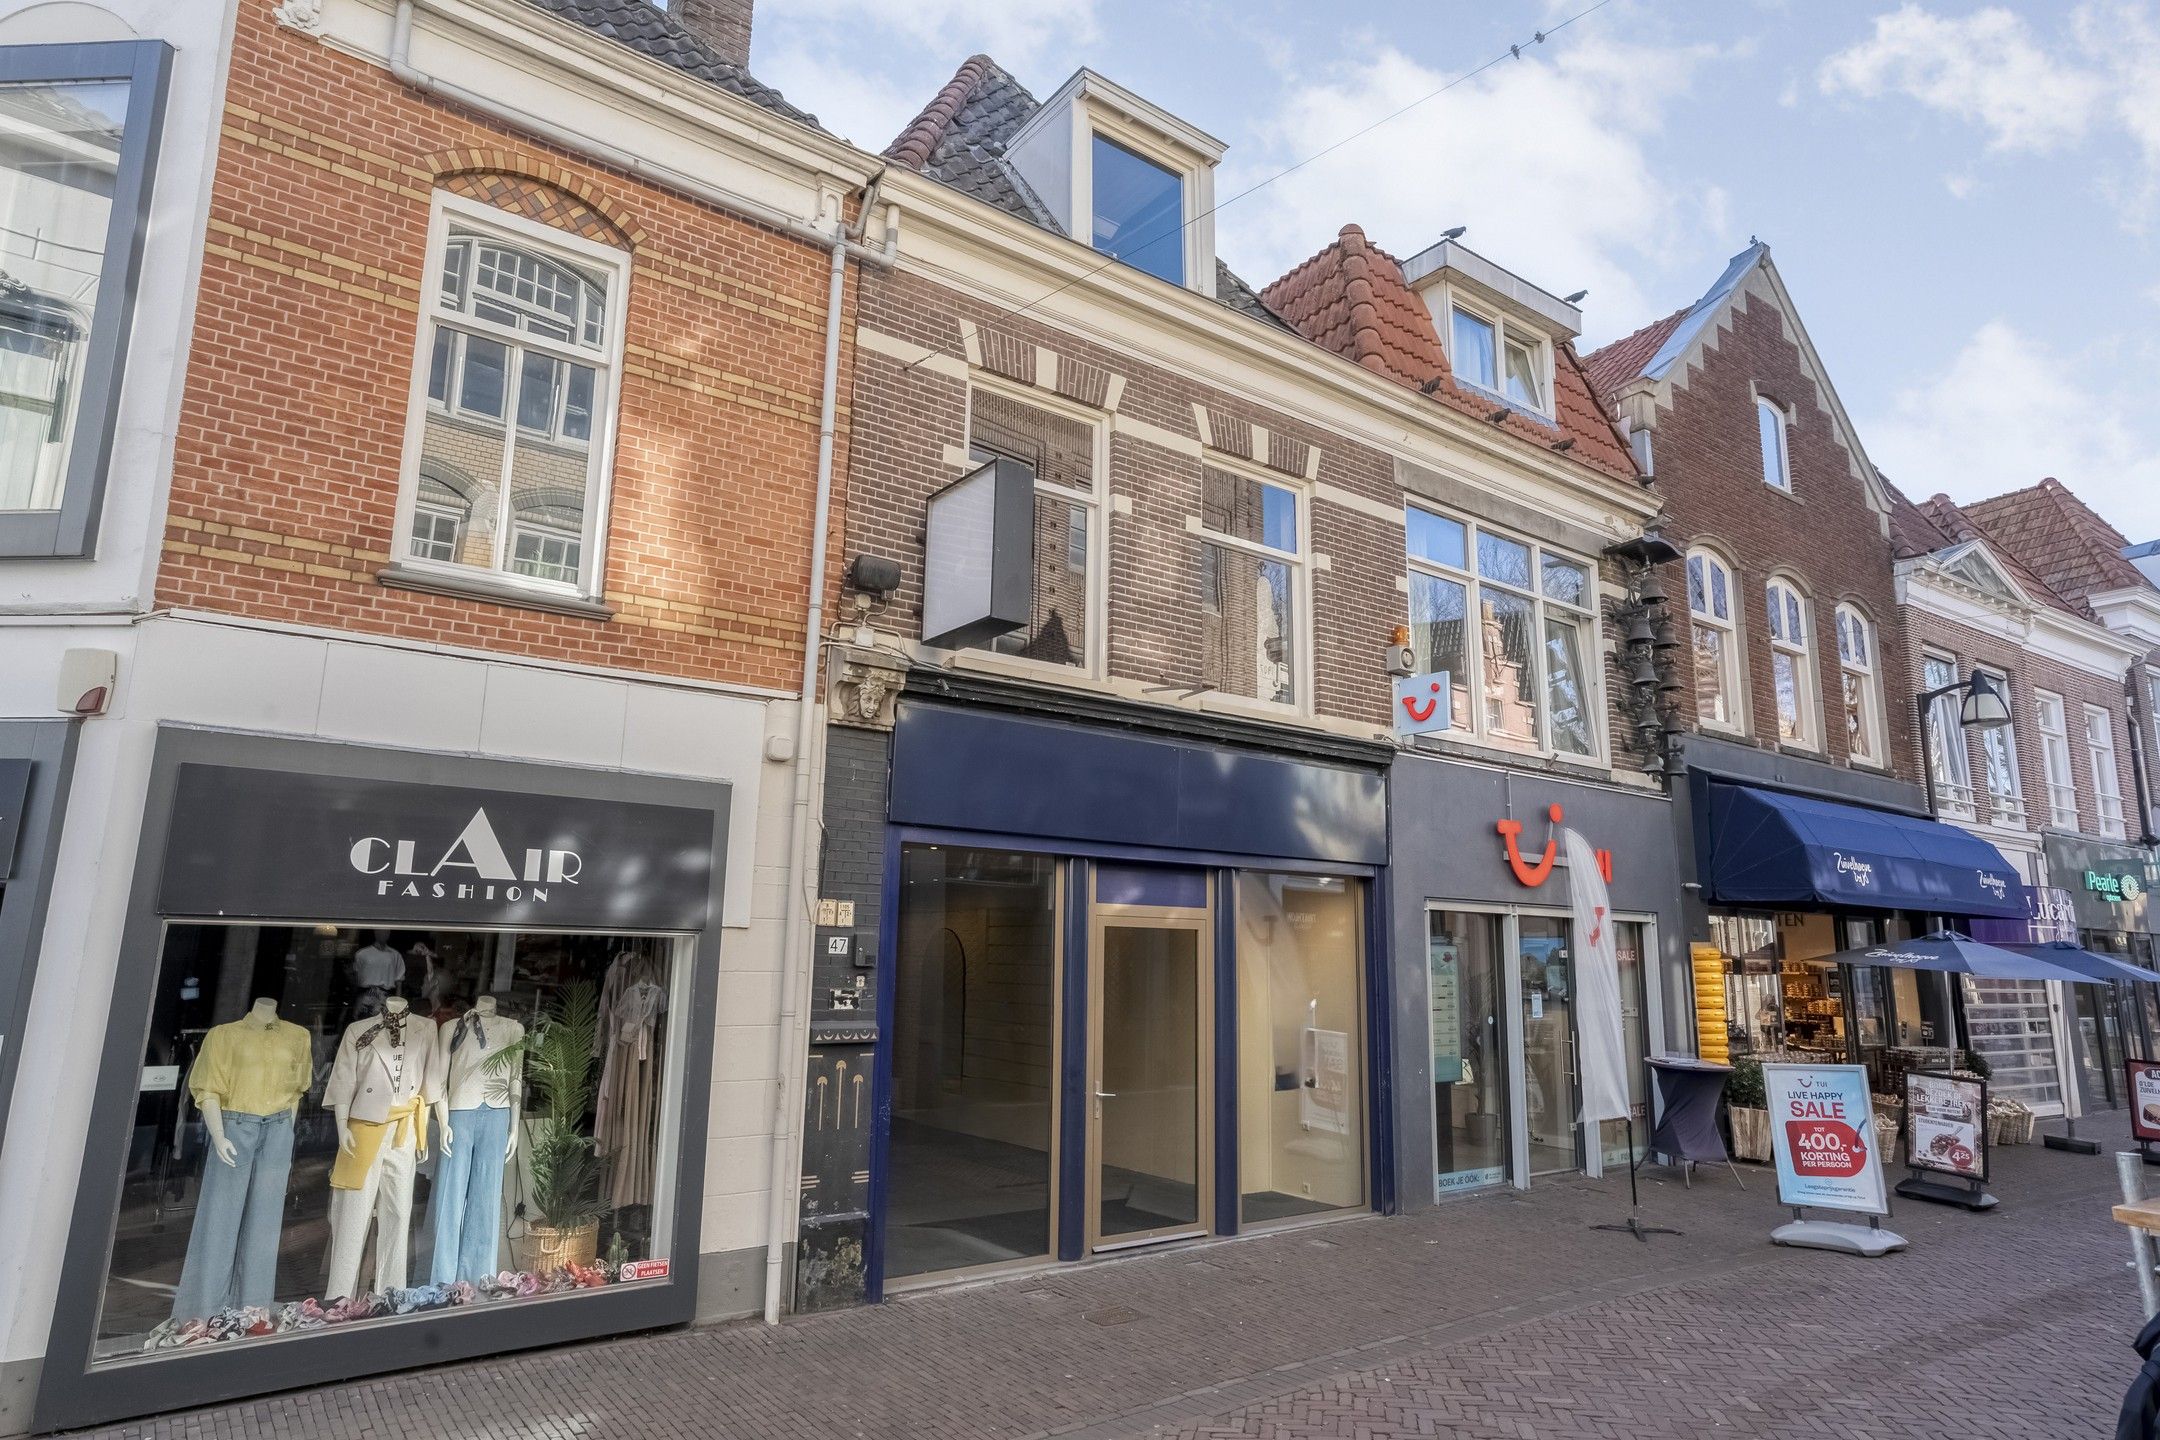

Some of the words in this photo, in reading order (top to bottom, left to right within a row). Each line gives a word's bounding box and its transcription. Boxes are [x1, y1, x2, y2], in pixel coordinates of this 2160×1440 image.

[350, 806, 582, 884] CLAIR
[2087, 870, 2120, 893] Pearle
[377, 880, 549, 902] FASHION
[829, 938, 847, 953] 47
[1616, 950, 1636, 961] SALE
[1787, 1091, 1808, 1099] LIVE
[1810, 1092, 1843, 1100] HAPPY
[1631, 1104, 1646, 1117] ALE
[1790, 1100, 1846, 1119] SALE
[1798, 1132, 1847, 1152] 400,-
[1800, 1151, 1851, 1162] KORTING
[1802, 1160, 1817, 1168] PER
[1817, 1161, 1852, 1169] PERSOON
[1438, 1178, 1456, 1188] BOEK
[1456, 1176, 1464, 1185] JE
